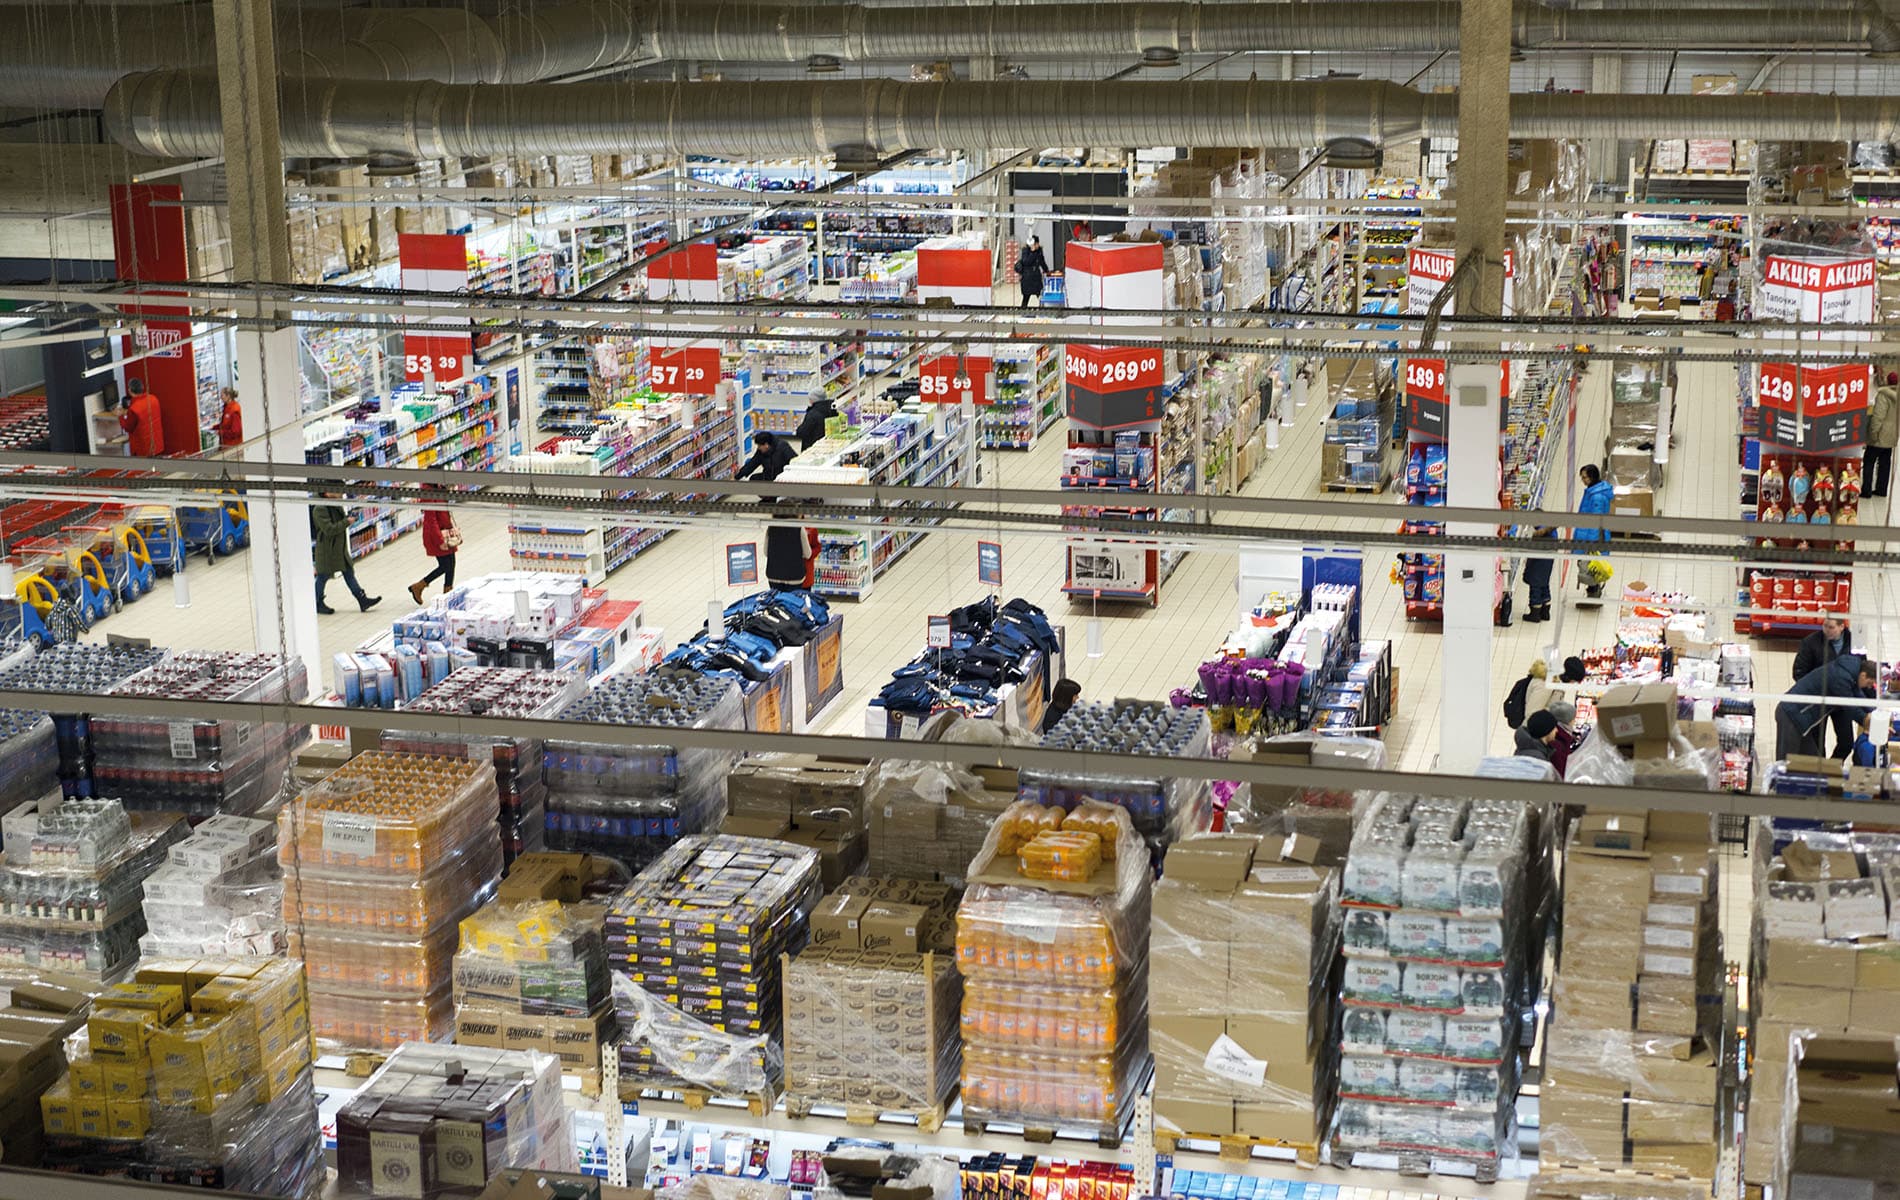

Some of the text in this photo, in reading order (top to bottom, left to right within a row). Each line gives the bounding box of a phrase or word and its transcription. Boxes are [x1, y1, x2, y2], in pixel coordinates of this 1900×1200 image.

[1412, 253, 1454, 279] АКЦІЯ
[1768, 261, 1821, 287] АКЦІЯ
[1826, 262, 1873, 287] АКЦІЯ
[151, 331, 179, 350] FOZZY
[406, 355, 456, 373] 53 39
[1066, 354, 1098, 378] 349 00
[1102, 358, 1156, 384] 269 00
[652, 366, 704, 384] 57 29
[920, 375, 948, 395] 85
[1407, 364, 1434, 389] 189
[1760, 375, 1794, 402] 129
[1816, 379, 1864, 407] 119 99
[1416, 973, 1448, 982] BORJOMI
[460, 1022, 498, 1034] SNICKERS
[506, 1026, 545, 1039] SNICKERS
[553, 1030, 592, 1042] SNICKERS
[1458, 1025, 1490, 1033] BORJOMI
